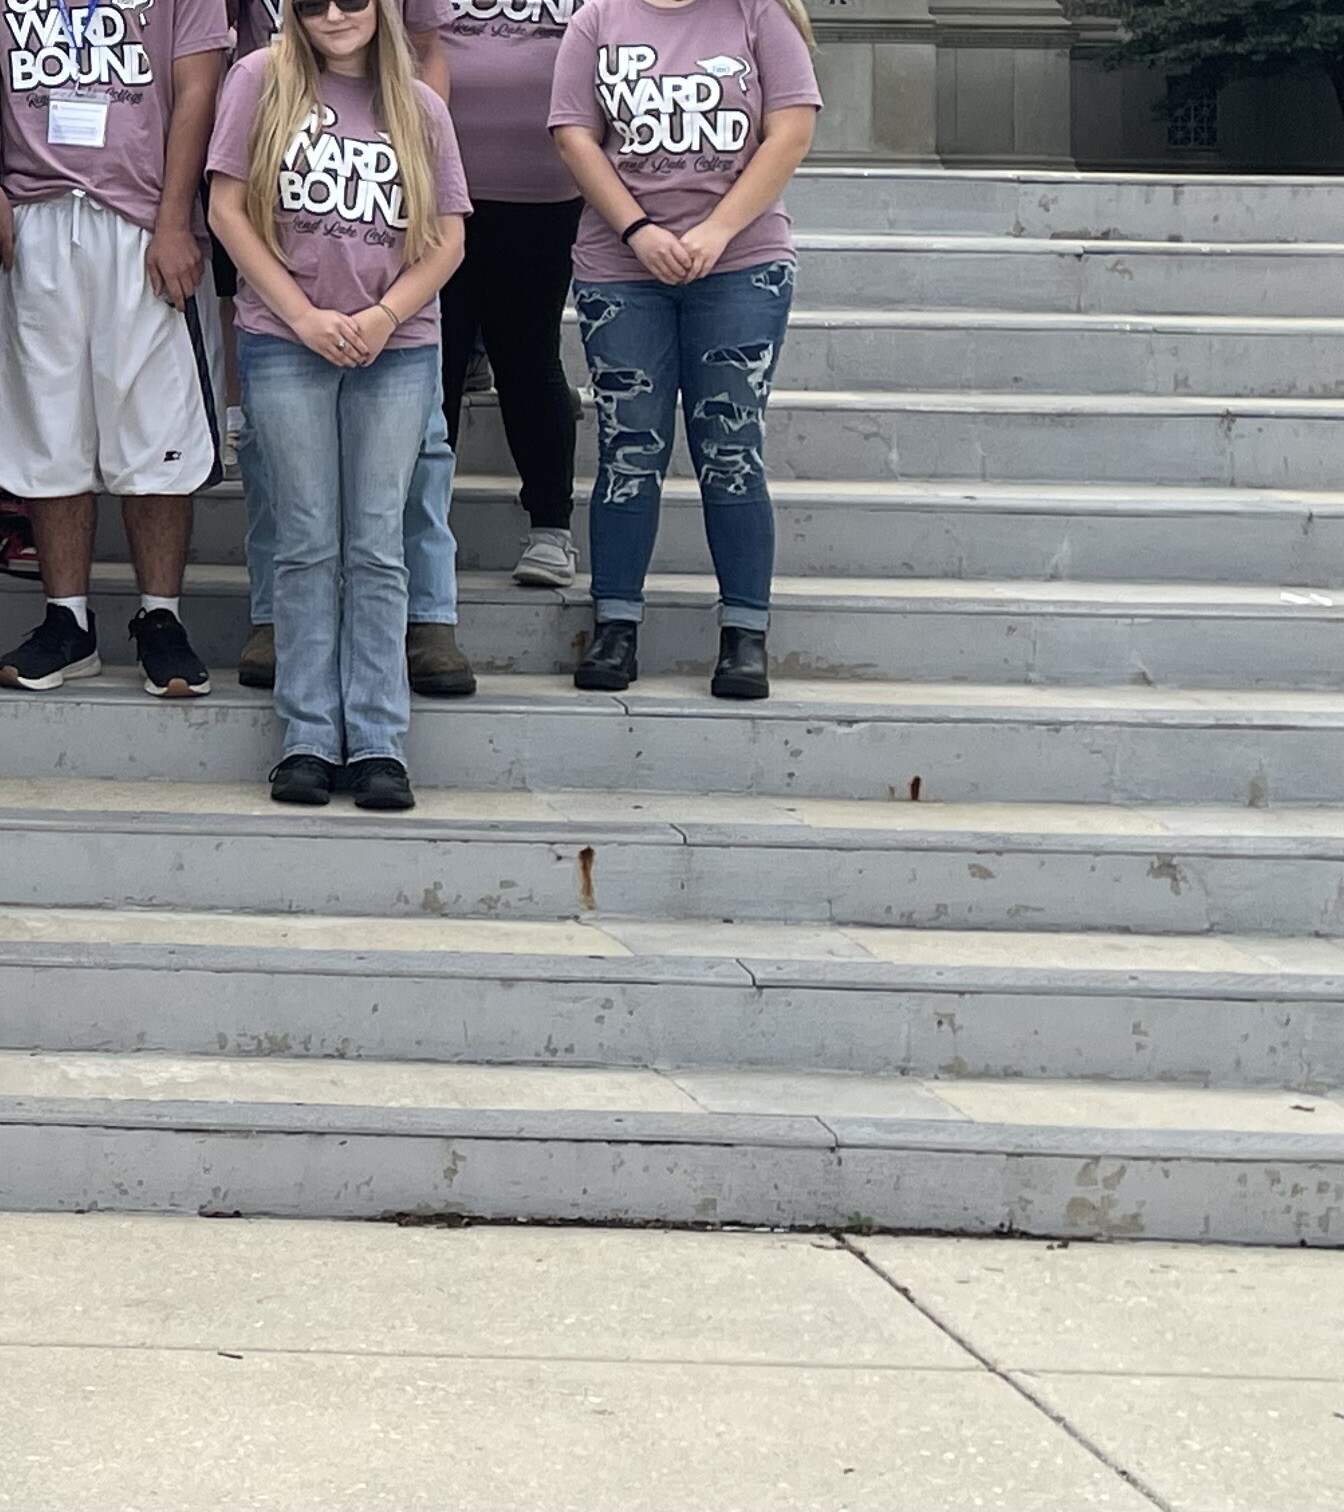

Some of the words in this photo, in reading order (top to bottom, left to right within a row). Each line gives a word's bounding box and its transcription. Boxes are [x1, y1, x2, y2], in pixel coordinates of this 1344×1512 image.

[8, 42, 154, 92] BOUND
[596, 44, 657, 86] UP
[596, 74, 723, 120] WARD
[613, 108, 751, 155] BOUND
